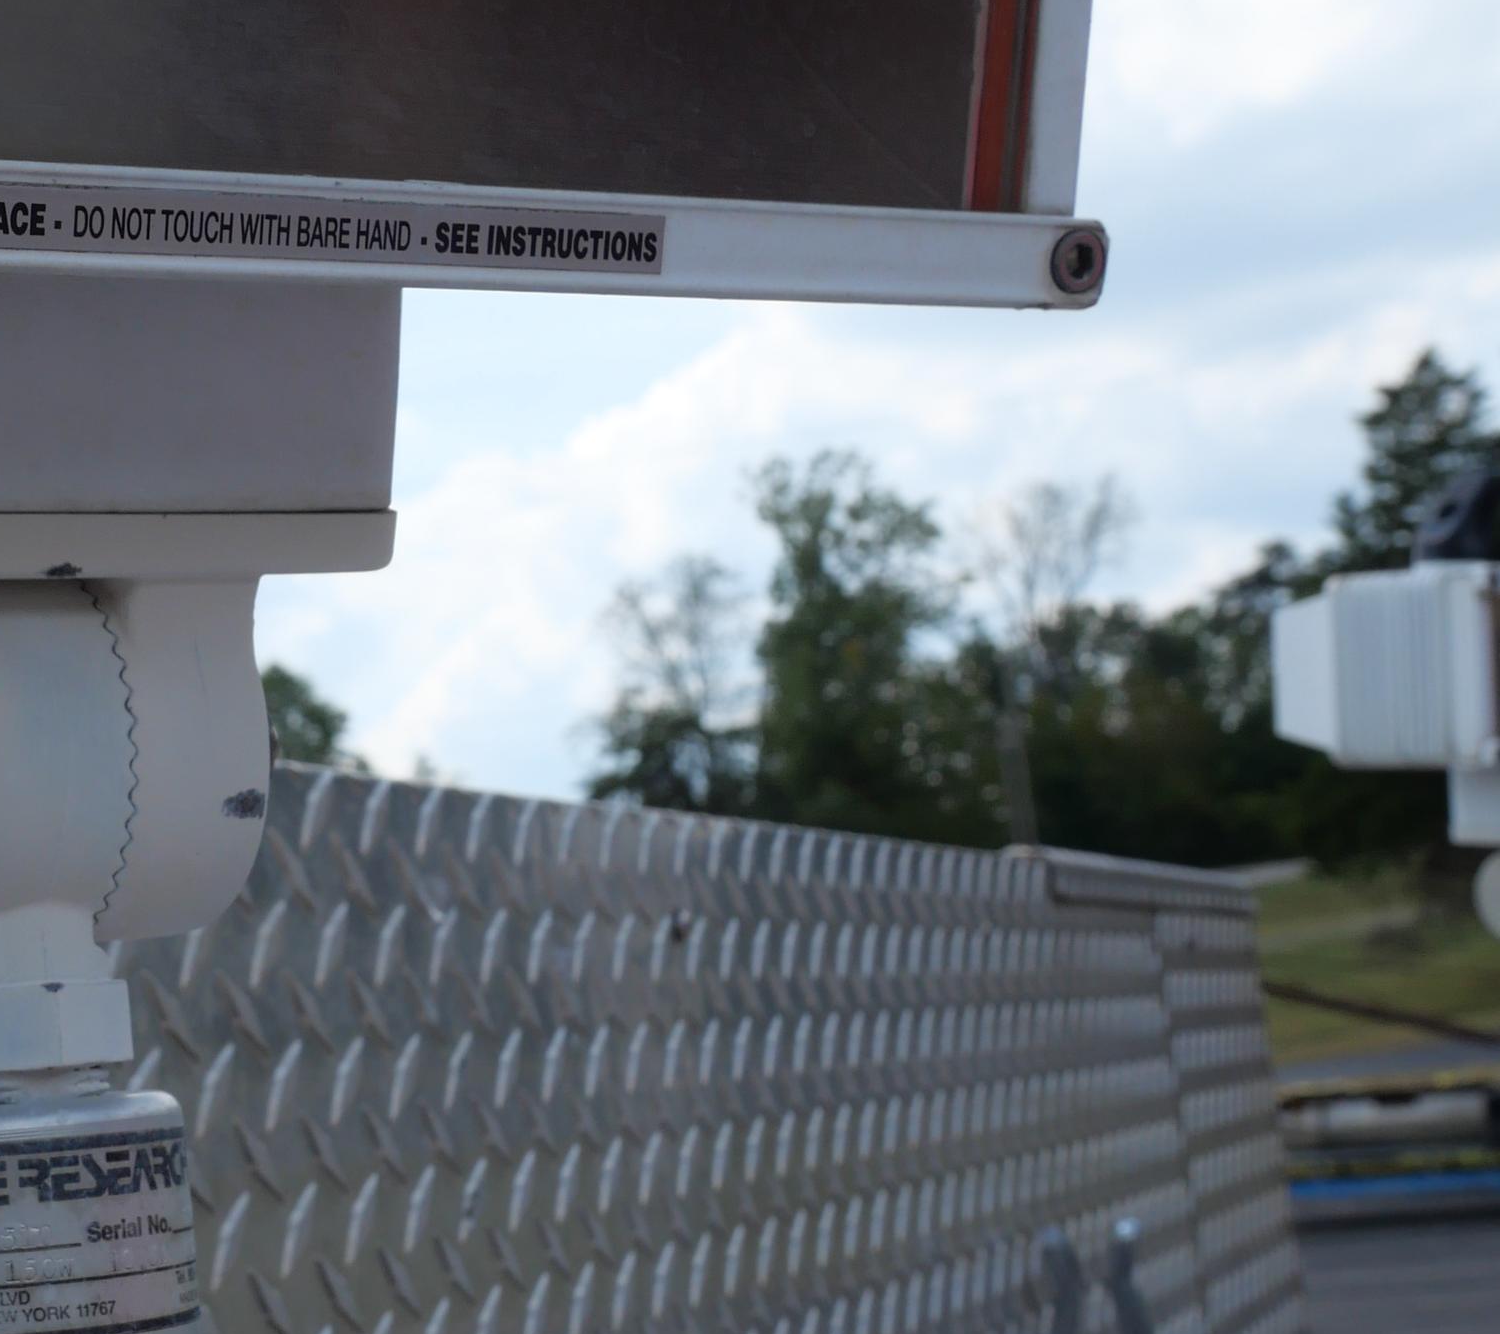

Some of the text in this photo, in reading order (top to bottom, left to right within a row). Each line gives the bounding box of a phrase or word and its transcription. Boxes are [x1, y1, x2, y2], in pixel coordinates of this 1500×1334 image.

[73, 205, 105, 238] DO
[111, 207, 156, 240] NOT
[162, 209, 234, 244] TOUCH
[241, 212, 290, 247] WITH
[297, 215, 351, 249] BARE
[356, 218, 412, 252] HAND
[435, 222, 481, 255] SEE
[487, 225, 658, 263] INSTRUCTIONS
[86, 1214, 173, 1244] Serial No.
[22, 1305, 71, 1323] YORK
[76, 1299, 117, 1317] 11767
